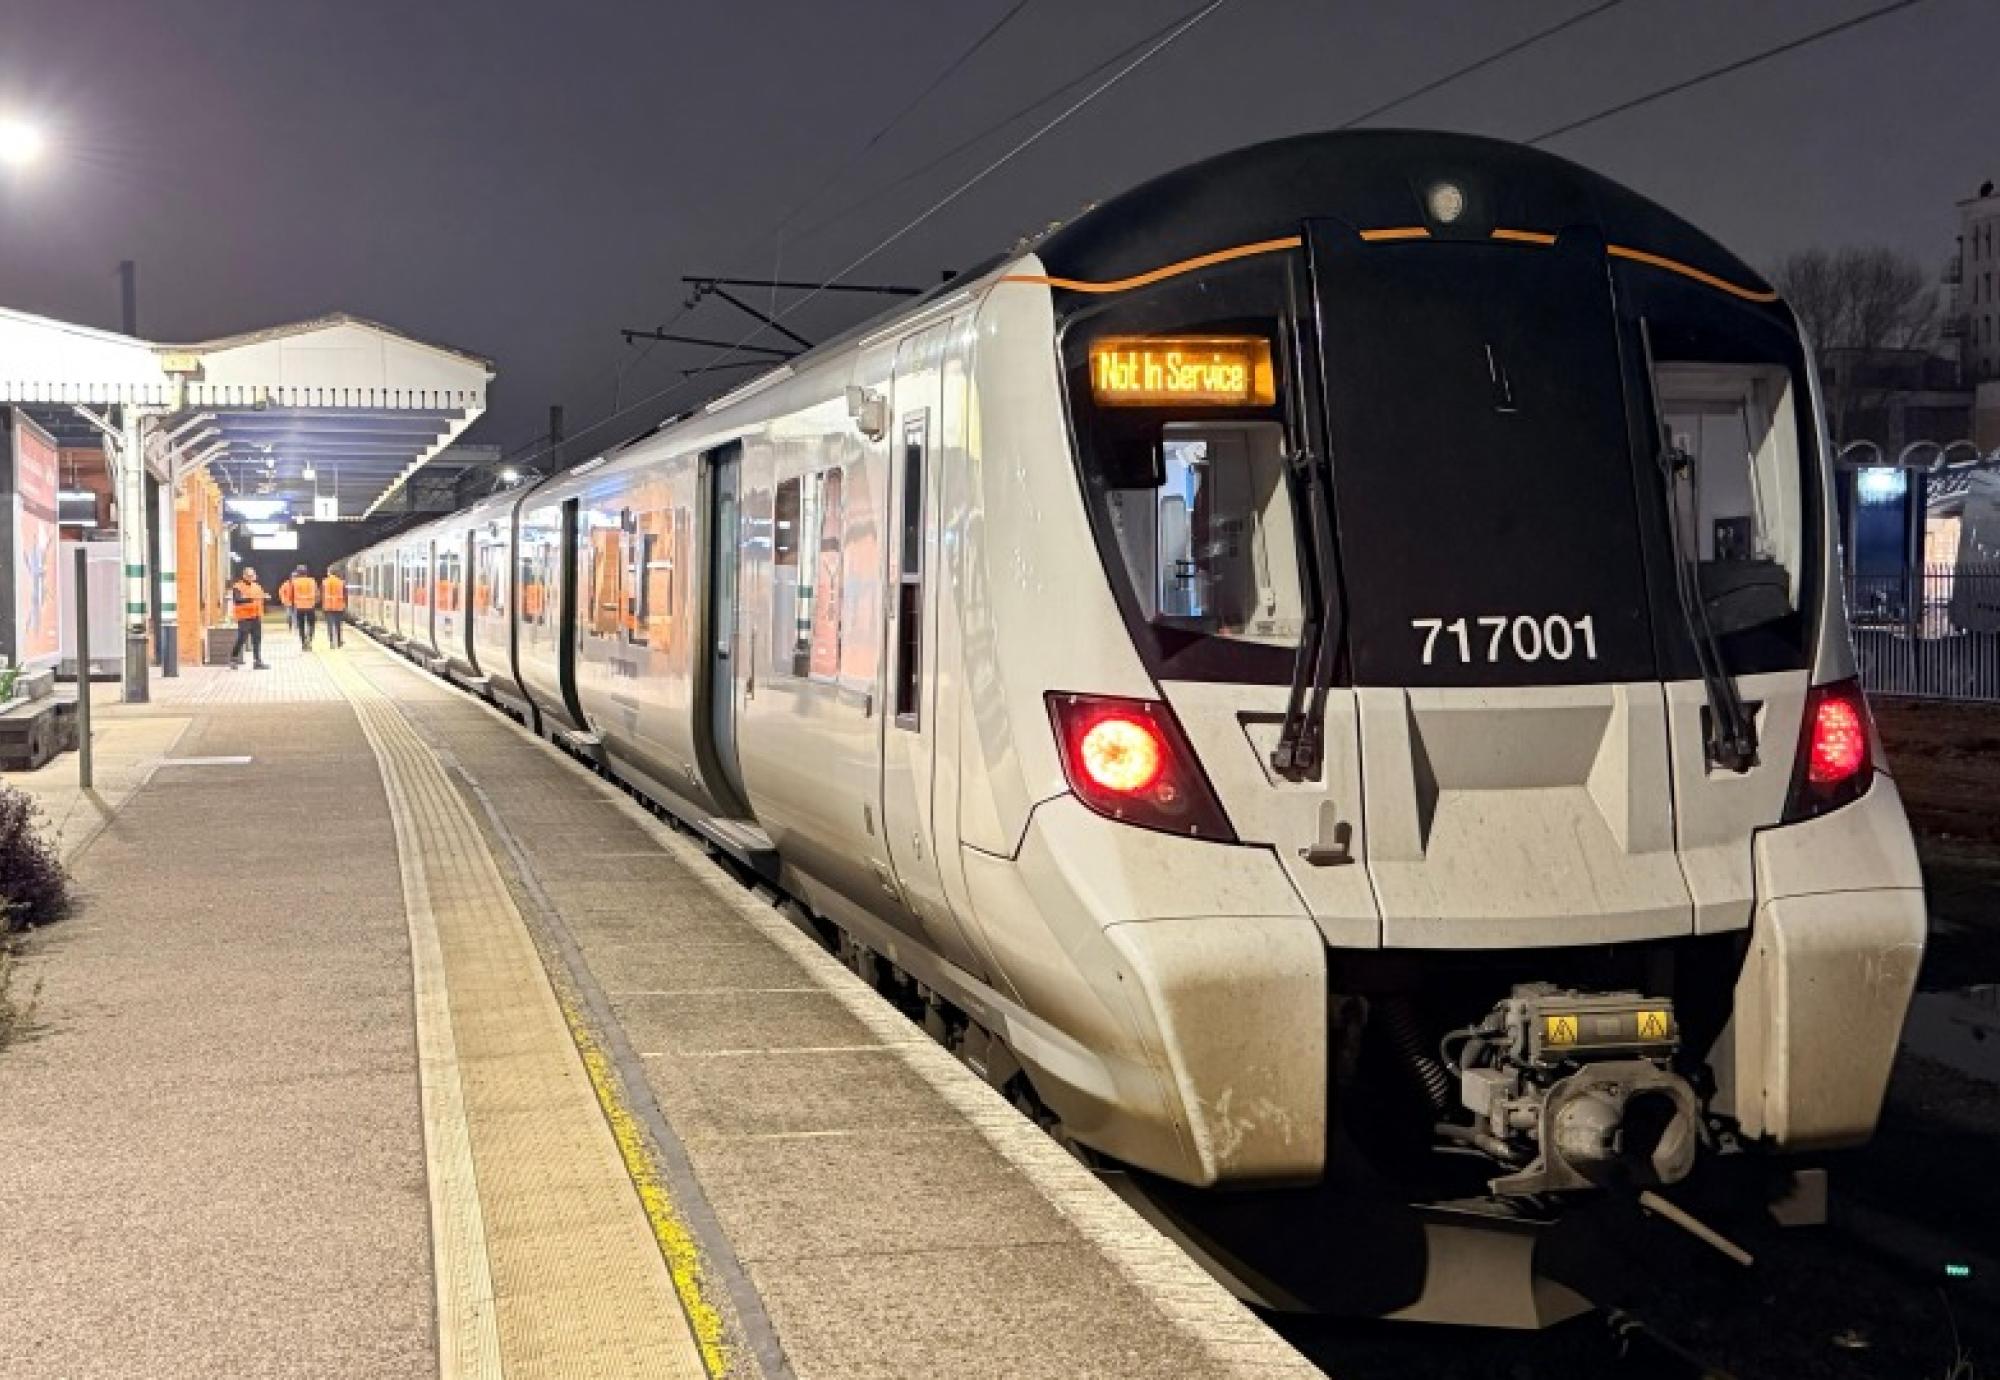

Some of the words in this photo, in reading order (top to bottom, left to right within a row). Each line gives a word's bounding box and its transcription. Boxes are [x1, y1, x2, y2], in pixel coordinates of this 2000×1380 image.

[1101, 352, 1140, 391] Not
[1144, 352, 1163, 391] In
[1167, 352, 1243, 391] Service
[1411, 614, 1598, 664] 717001
